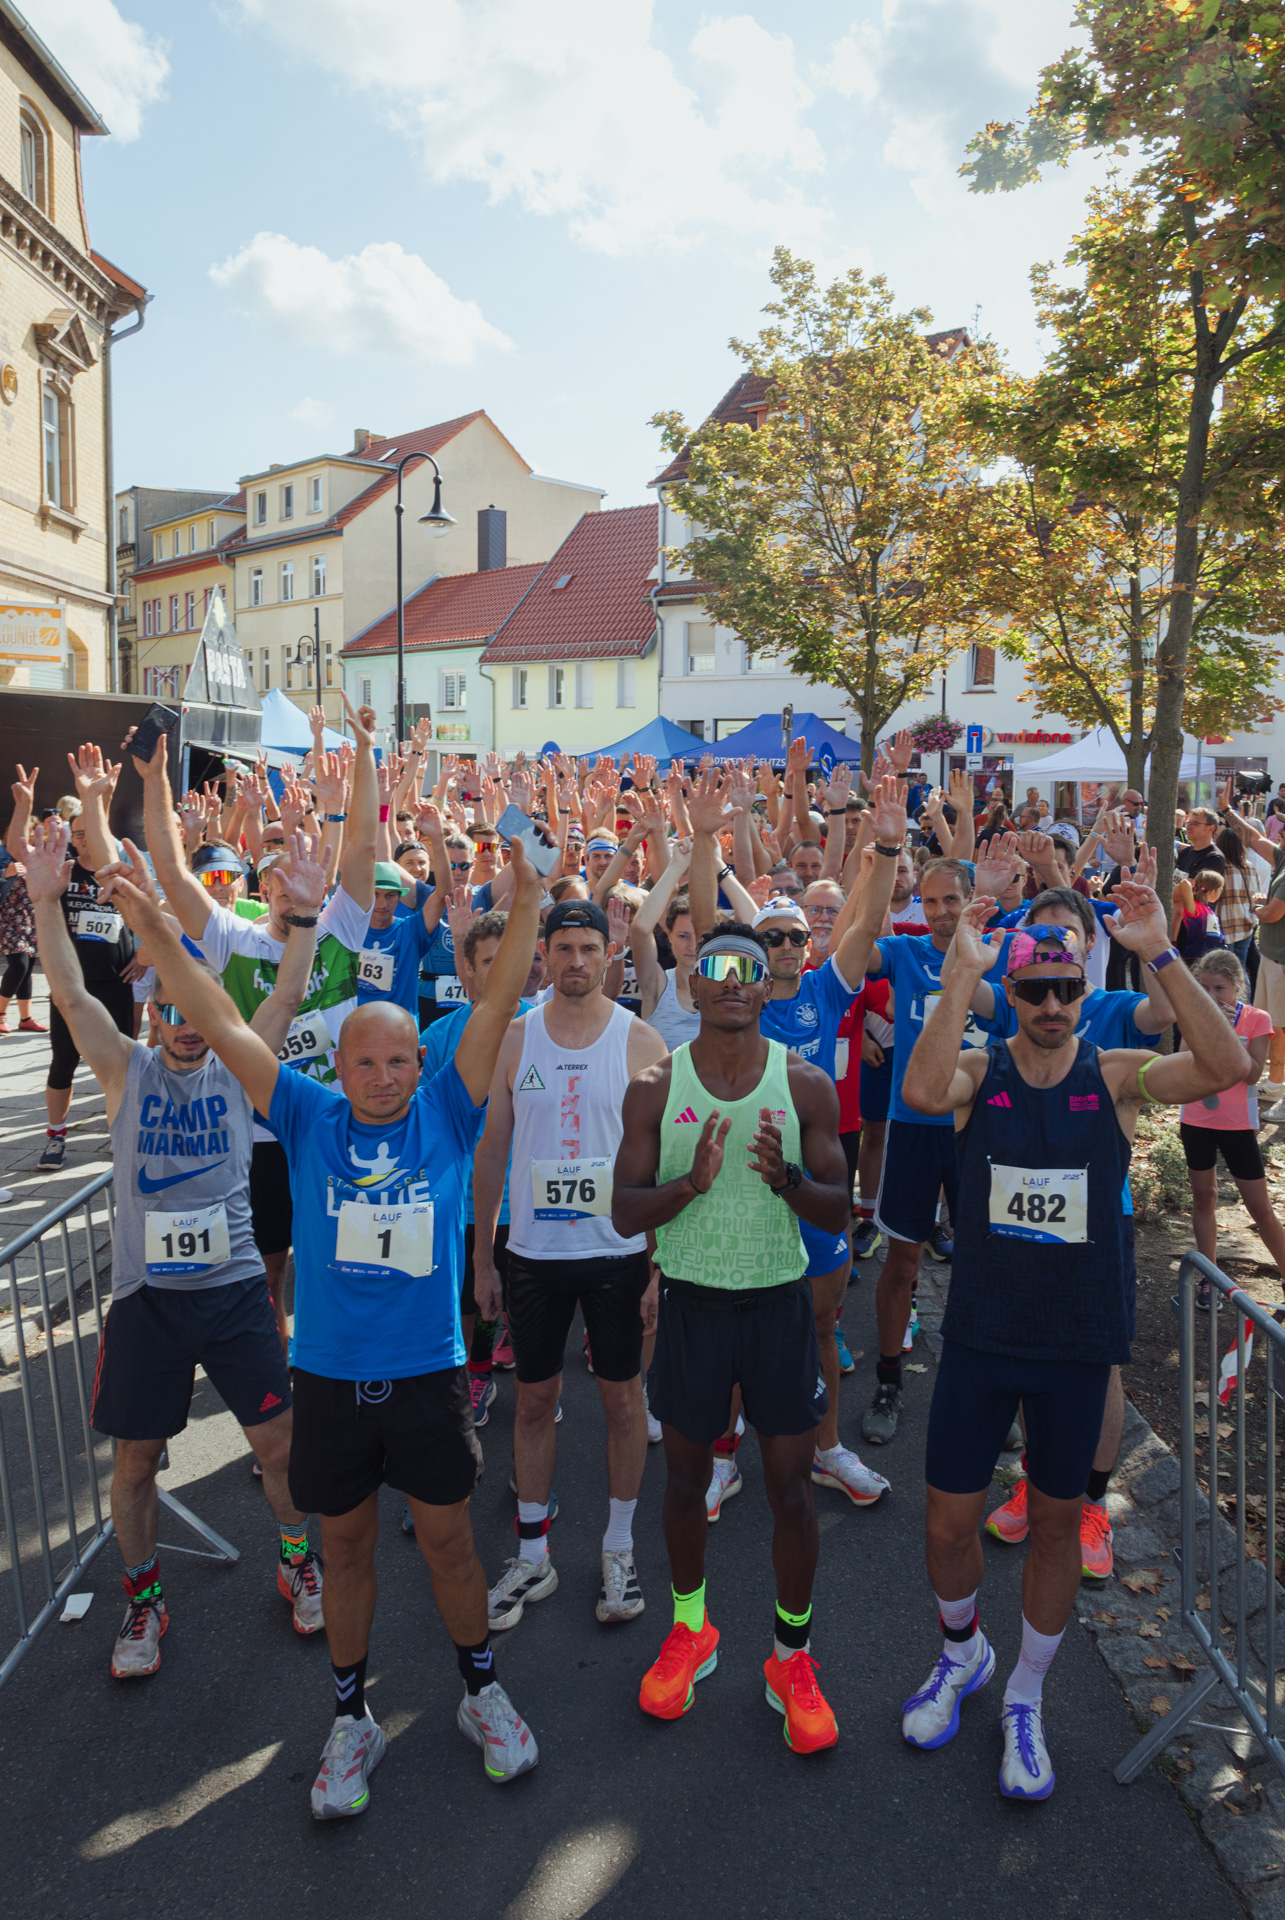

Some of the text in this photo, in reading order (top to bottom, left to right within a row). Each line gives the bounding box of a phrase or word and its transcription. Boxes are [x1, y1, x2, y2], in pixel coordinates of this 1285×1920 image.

[206, 648, 247, 689] PASTA
[996, 729, 1072, 744] vodafone
[86, 921, 112, 934] 507
[140, 1094, 228, 1134] CAMP
[137, 1130, 230, 1157] MARMAL
[557, 1165, 581, 1175] LAUF
[1022, 1177, 1051, 1187] LAUF
[546, 1178, 596, 1205] 576
[373, 1212, 402, 1222] LAUF
[1007, 1192, 1066, 1224] 482
[172, 1217, 199, 1227] LAUF
[161, 1228, 210, 1258] 191
[377, 1229, 392, 1259] 1
